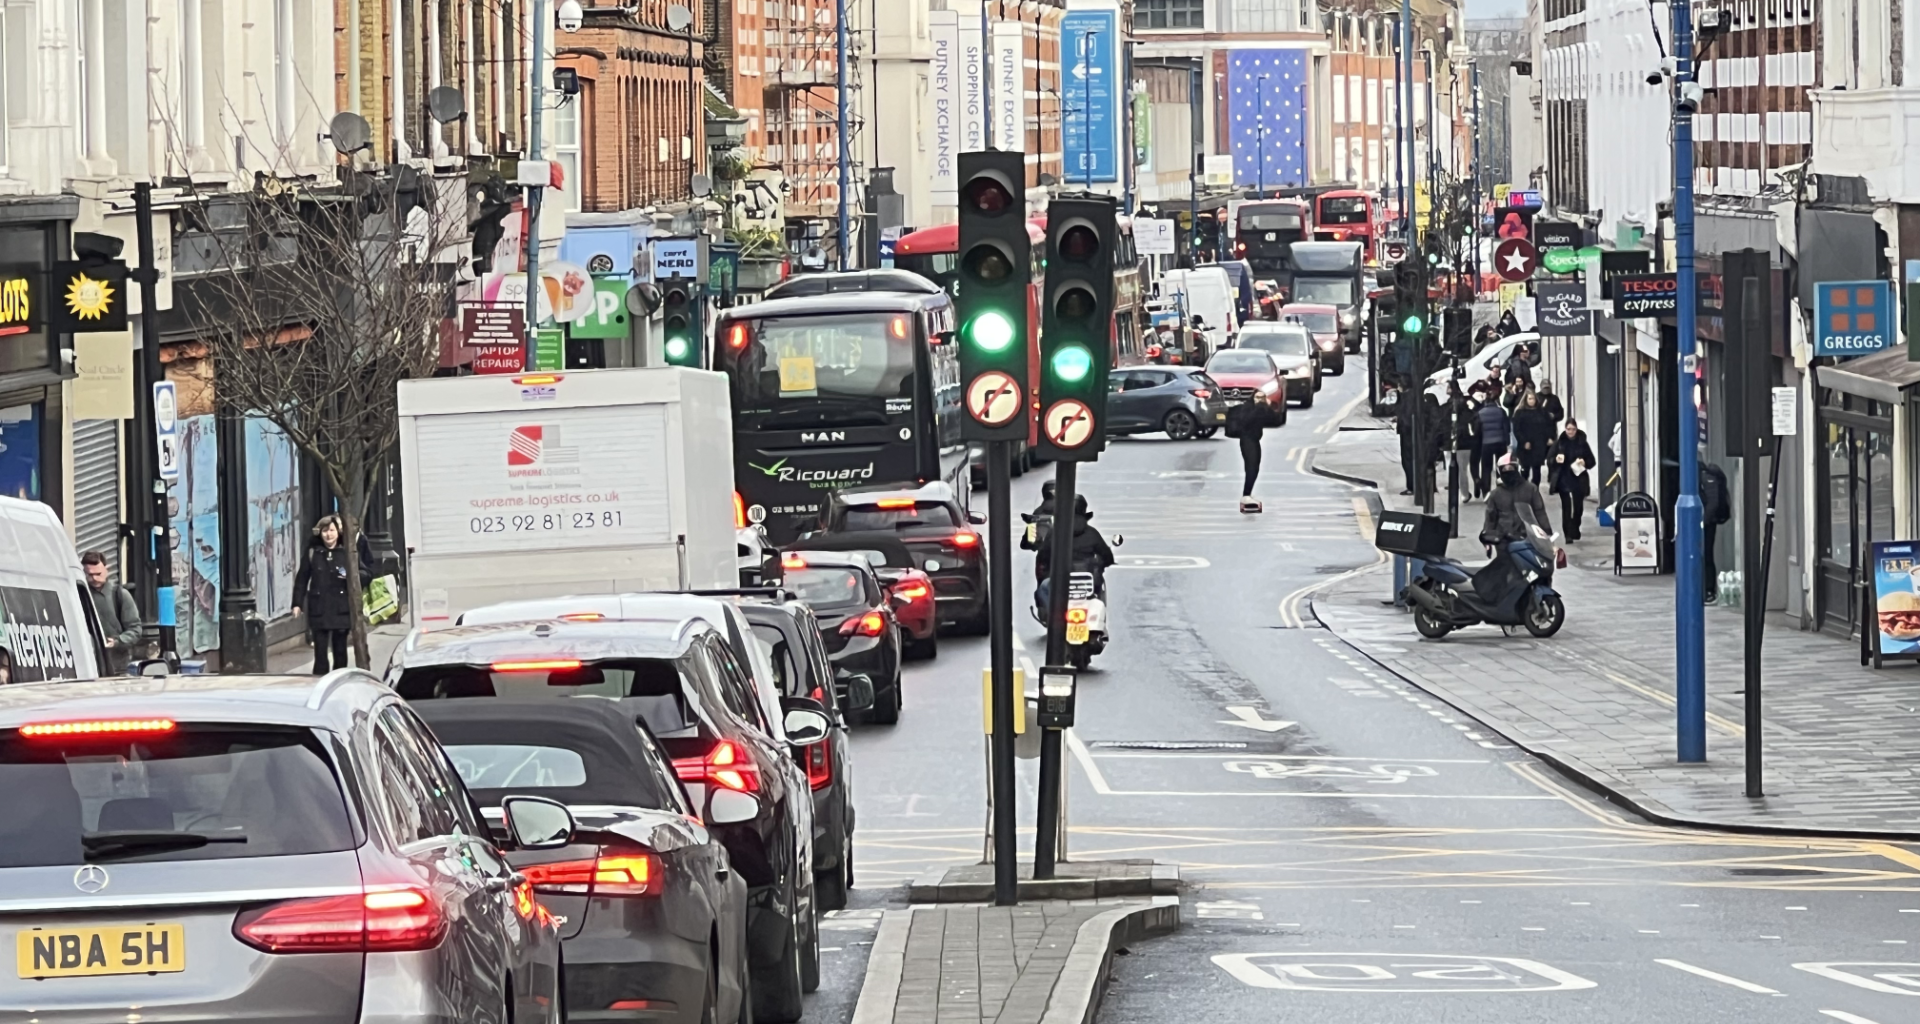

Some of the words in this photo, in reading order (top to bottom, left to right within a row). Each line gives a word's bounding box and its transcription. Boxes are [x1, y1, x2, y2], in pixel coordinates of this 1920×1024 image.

[936, 40, 948, 92] PUTNEY
[1003, 48, 1014, 95] PUTNEY
[967, 46, 979, 115] SHOPPING
[937, 98, 950, 176] EXCHANGE
[1544, 234, 1570, 244] vision
[658, 259, 694, 268] NERO
[1622, 280, 1676, 292] TESCO
[1557, 301, 1573, 318] &
[1624, 299, 1675, 312] express
[1824, 335, 1883, 349] GREGGS
[801, 432, 846, 444] MAN
[778, 462, 874, 482] Ricouard
[470, 516, 506, 534] 023
[512, 515, 535, 532] 92
[543, 514, 562, 530] 81
[572, 512, 595, 528] 23
[602, 511, 622, 528] 81
[33, 933, 107, 970] NBA
[122, 930, 169, 966] 5H
